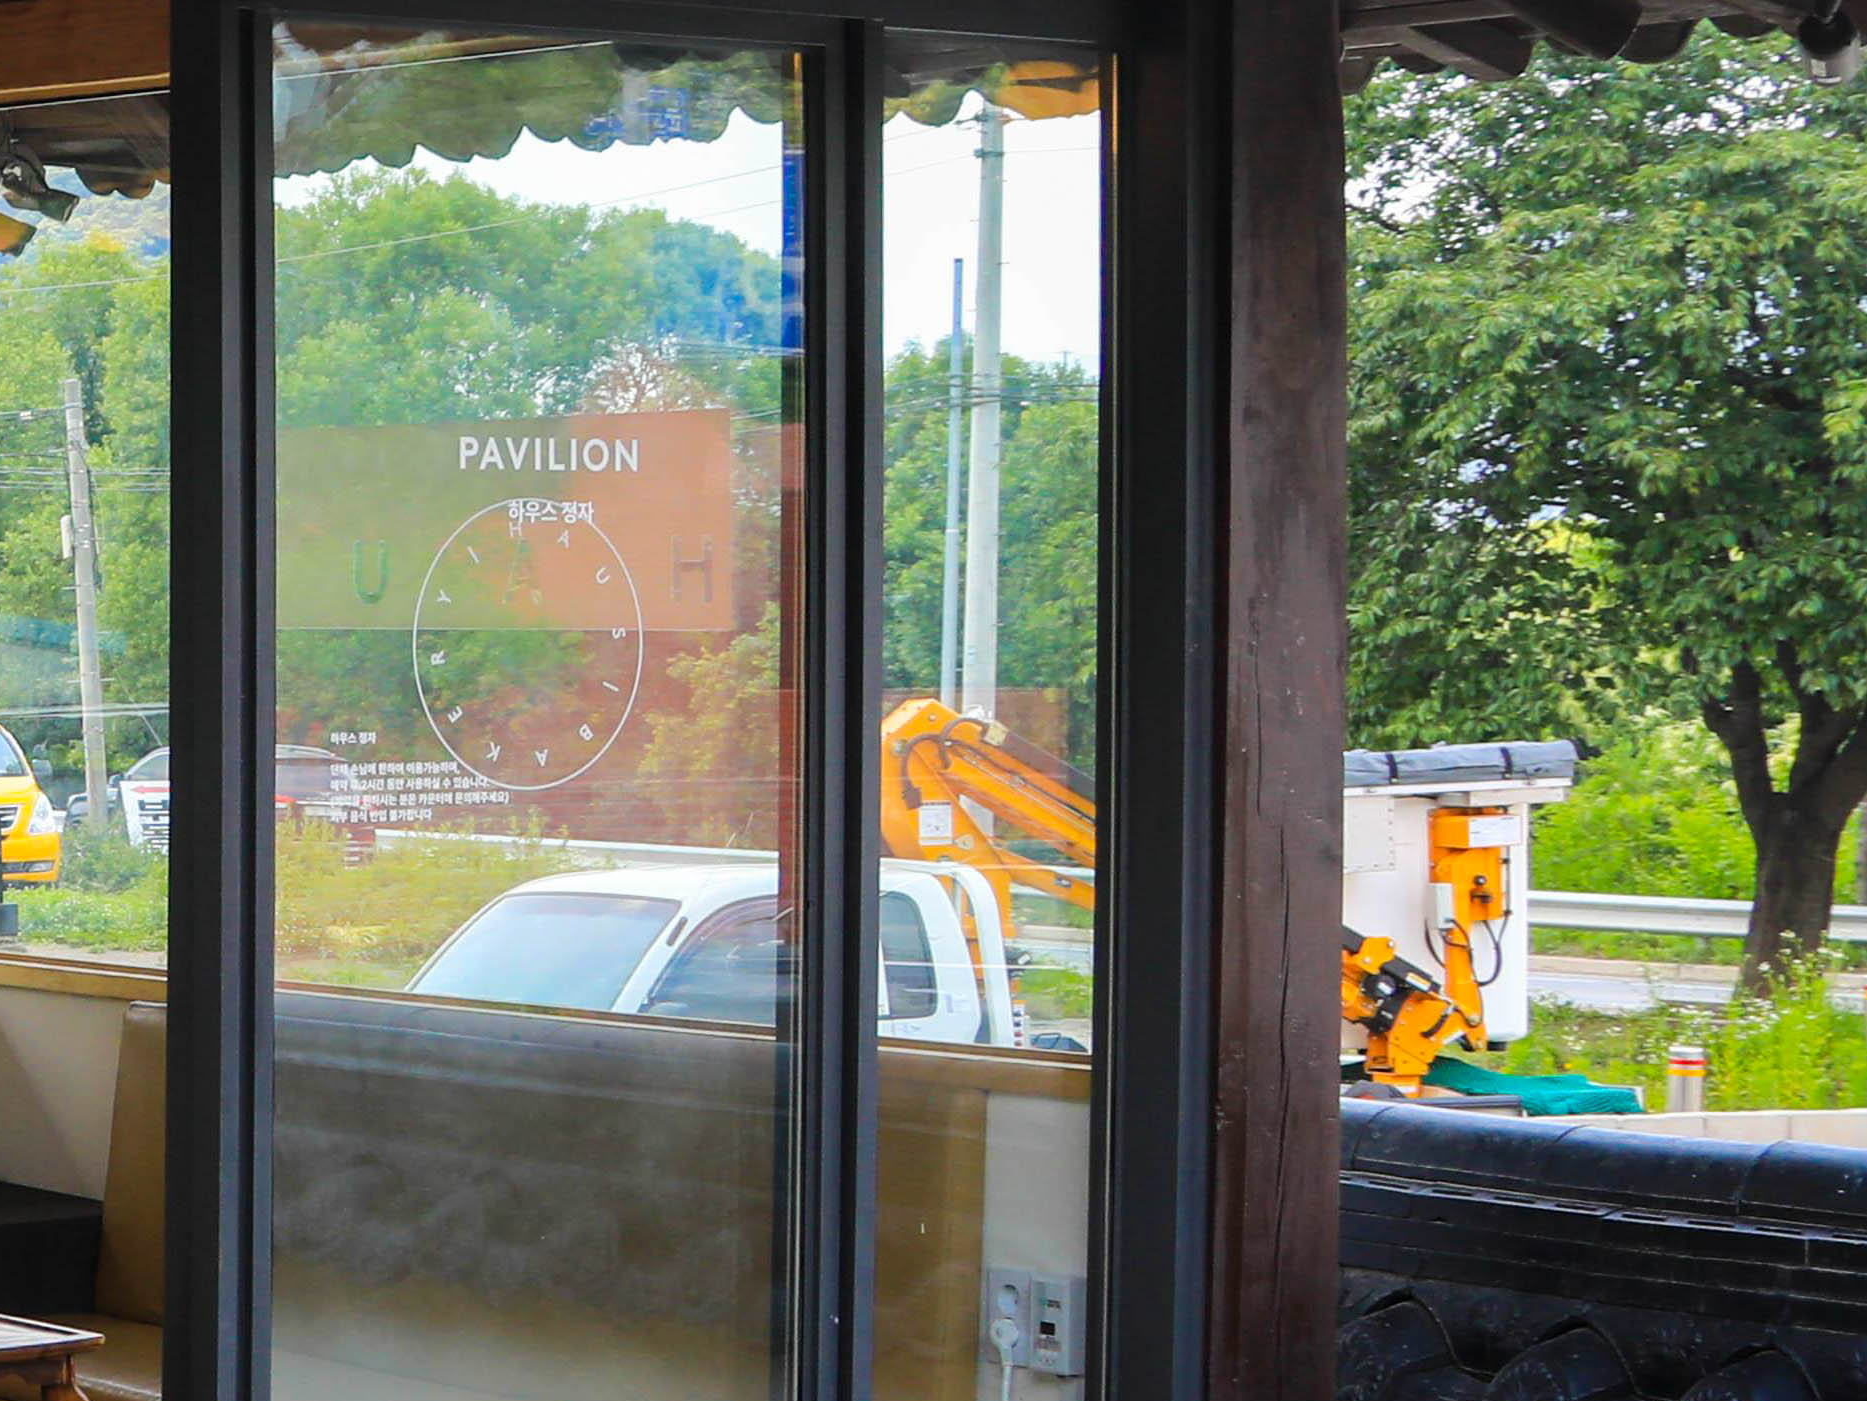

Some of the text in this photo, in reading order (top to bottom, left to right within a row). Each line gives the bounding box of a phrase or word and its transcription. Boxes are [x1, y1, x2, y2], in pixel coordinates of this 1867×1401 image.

[458, 435, 640, 473] PAVILION
[507, 500, 595, 525] 하우스 정자
[330, 731, 358, 745] 하우스
[442, 777, 452, 790] 수
